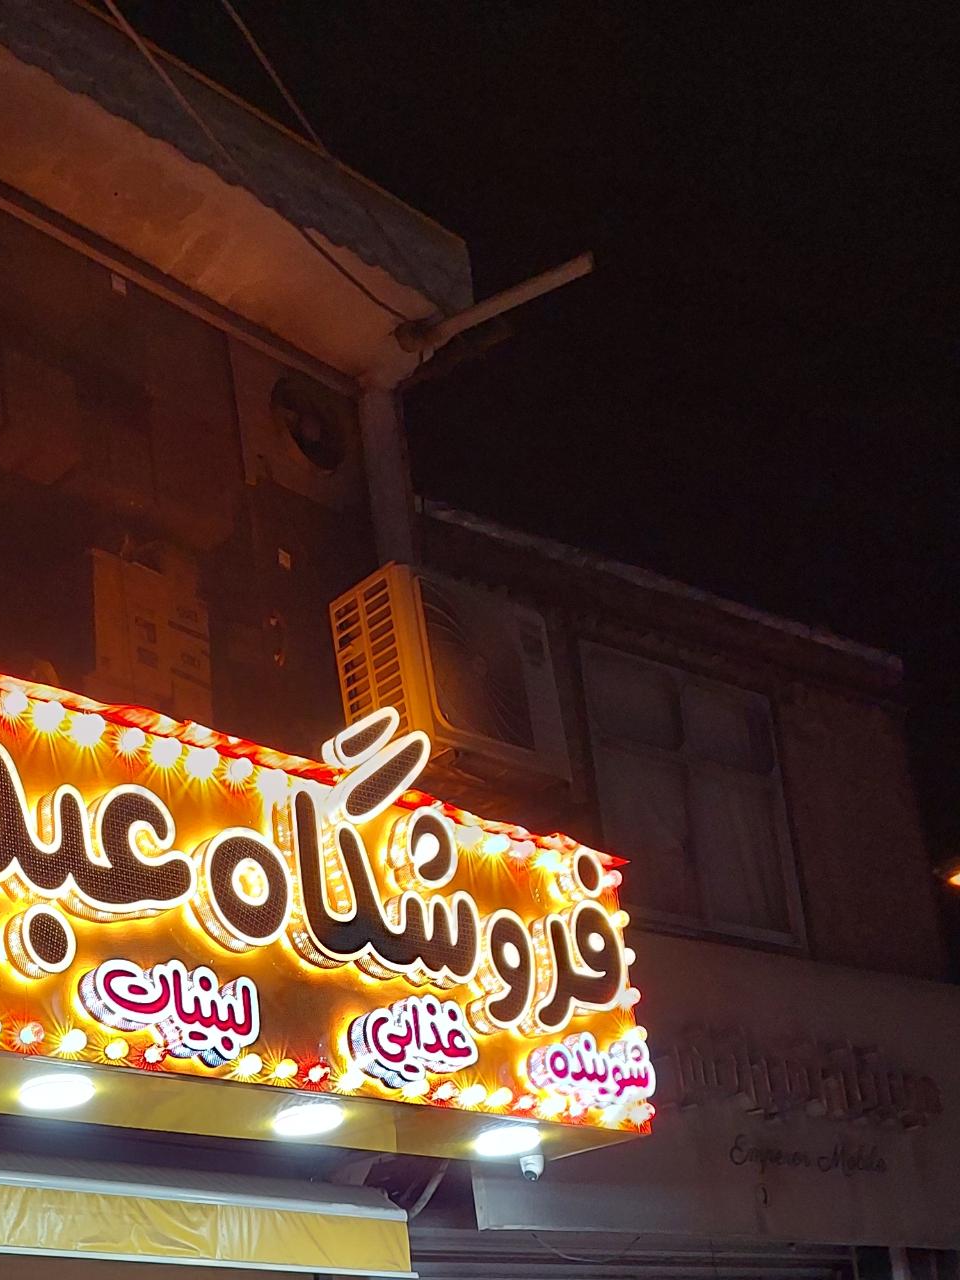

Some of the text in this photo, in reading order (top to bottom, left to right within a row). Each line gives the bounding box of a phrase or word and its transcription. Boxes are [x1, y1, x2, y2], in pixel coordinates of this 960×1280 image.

[192, 706, 628, 1037] فروشگاه
[98, 964, 255, 1053] لبنیات
[370, 1000, 473, 1073] غذایی
[547, 1037, 651, 1098] شوینده
